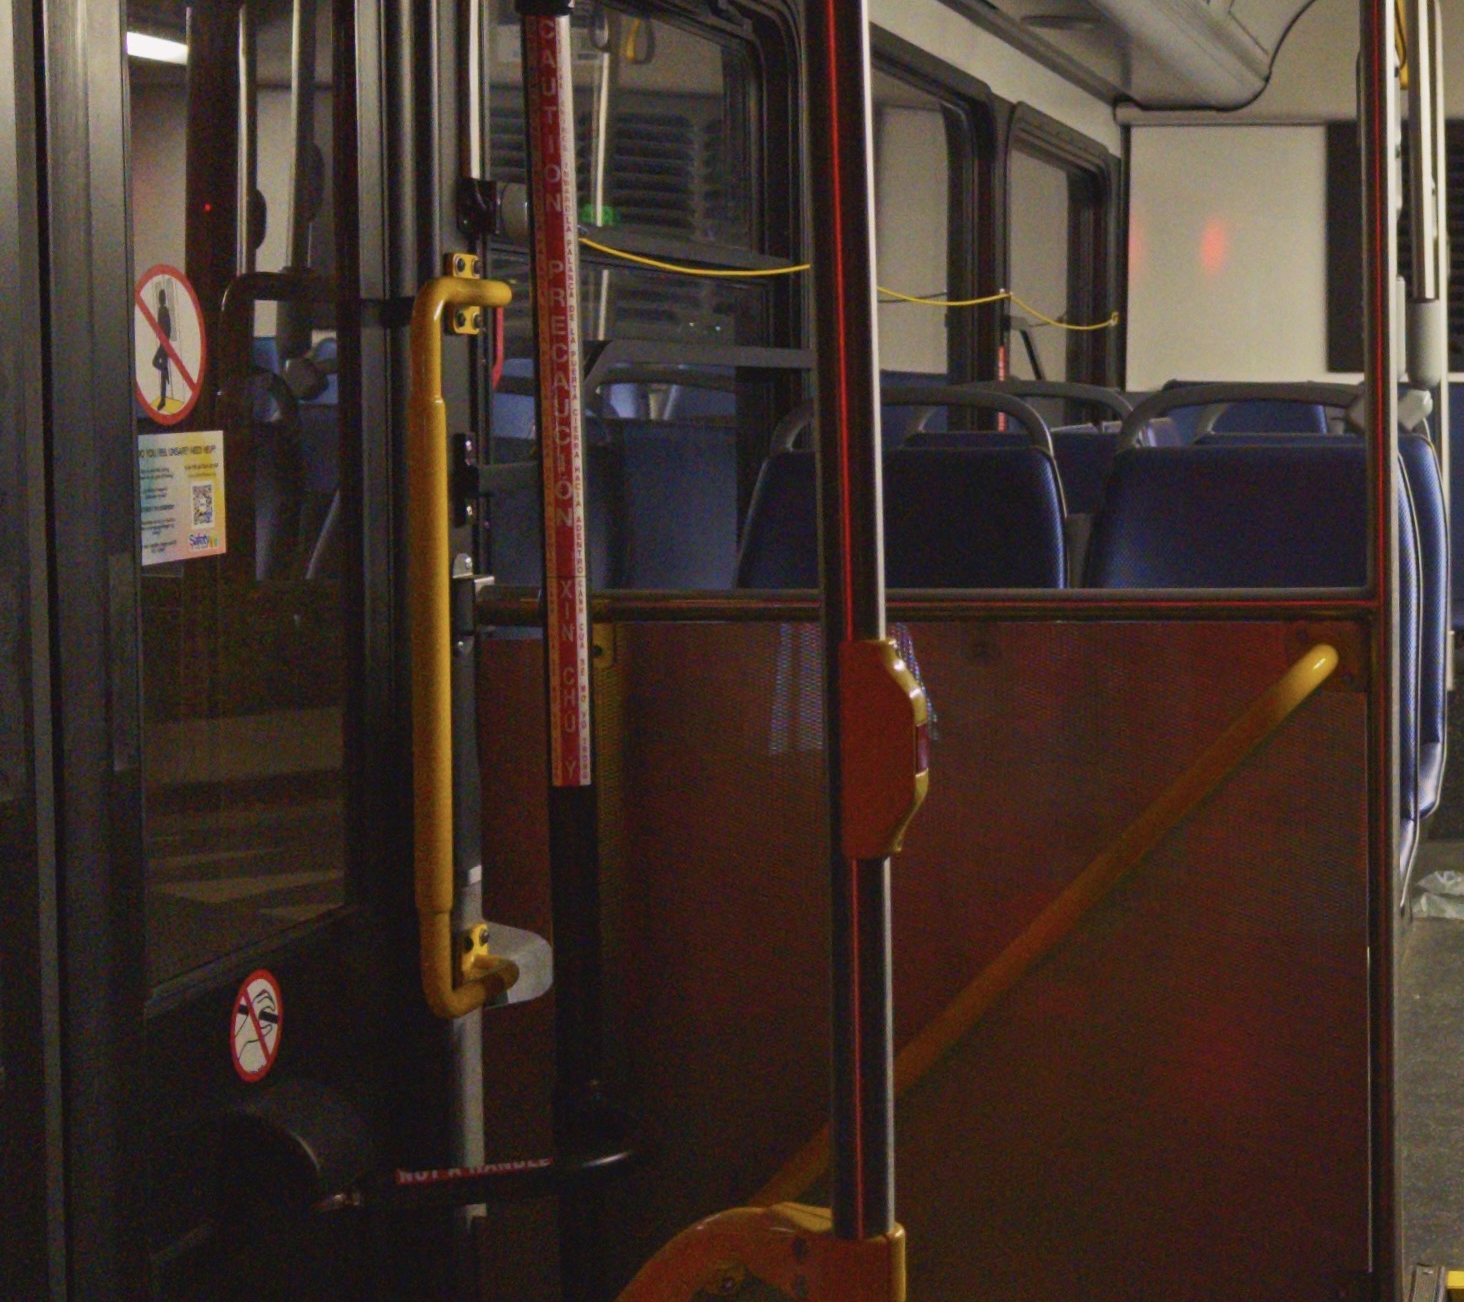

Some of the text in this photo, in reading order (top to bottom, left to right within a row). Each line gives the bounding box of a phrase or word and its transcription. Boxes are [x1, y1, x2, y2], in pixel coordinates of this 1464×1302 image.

[539, 19, 562, 212] CAUTION
[548, 260, 573, 527] PRECAUCIÓN
[567, 239, 575, 297] PALANCA
[574, 467, 582, 507] HACIA
